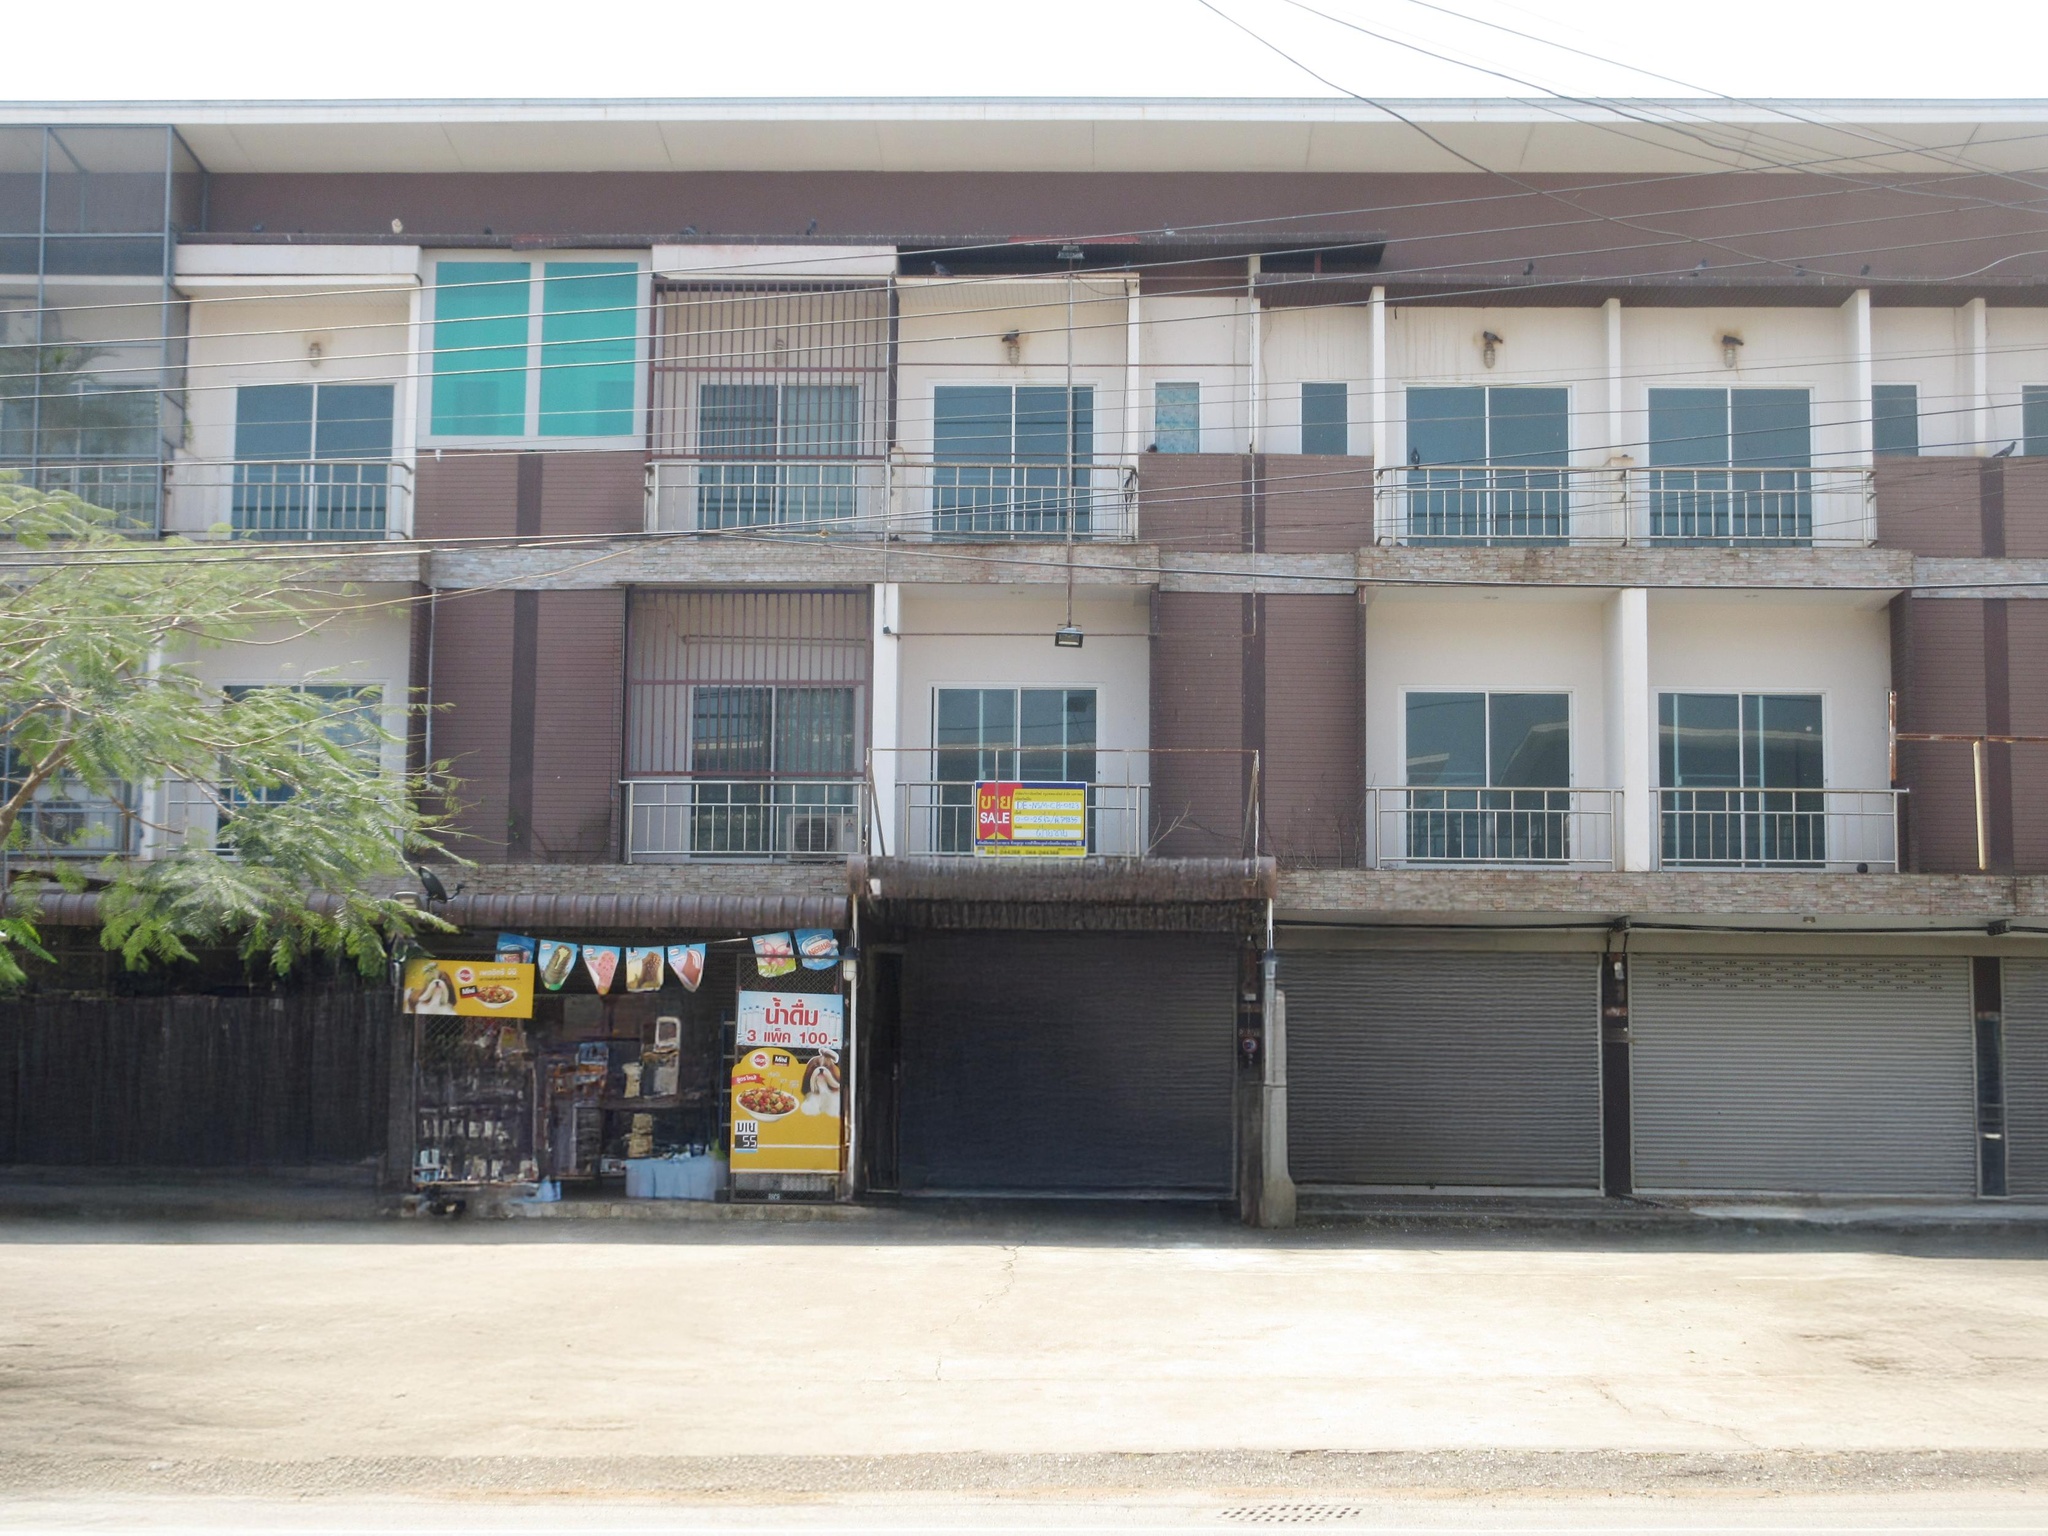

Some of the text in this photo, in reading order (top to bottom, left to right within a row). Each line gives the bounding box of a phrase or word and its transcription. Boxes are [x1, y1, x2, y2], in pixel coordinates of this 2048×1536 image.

[981, 796, 1010, 809] ขาย
[980, 812, 1010, 824] SALE
[765, 997, 819, 1026] น้ำดื่ม
[746, 1028, 838, 1045] 3 แพ็ค 100.-
[742, 1135, 757, 1147] 55
